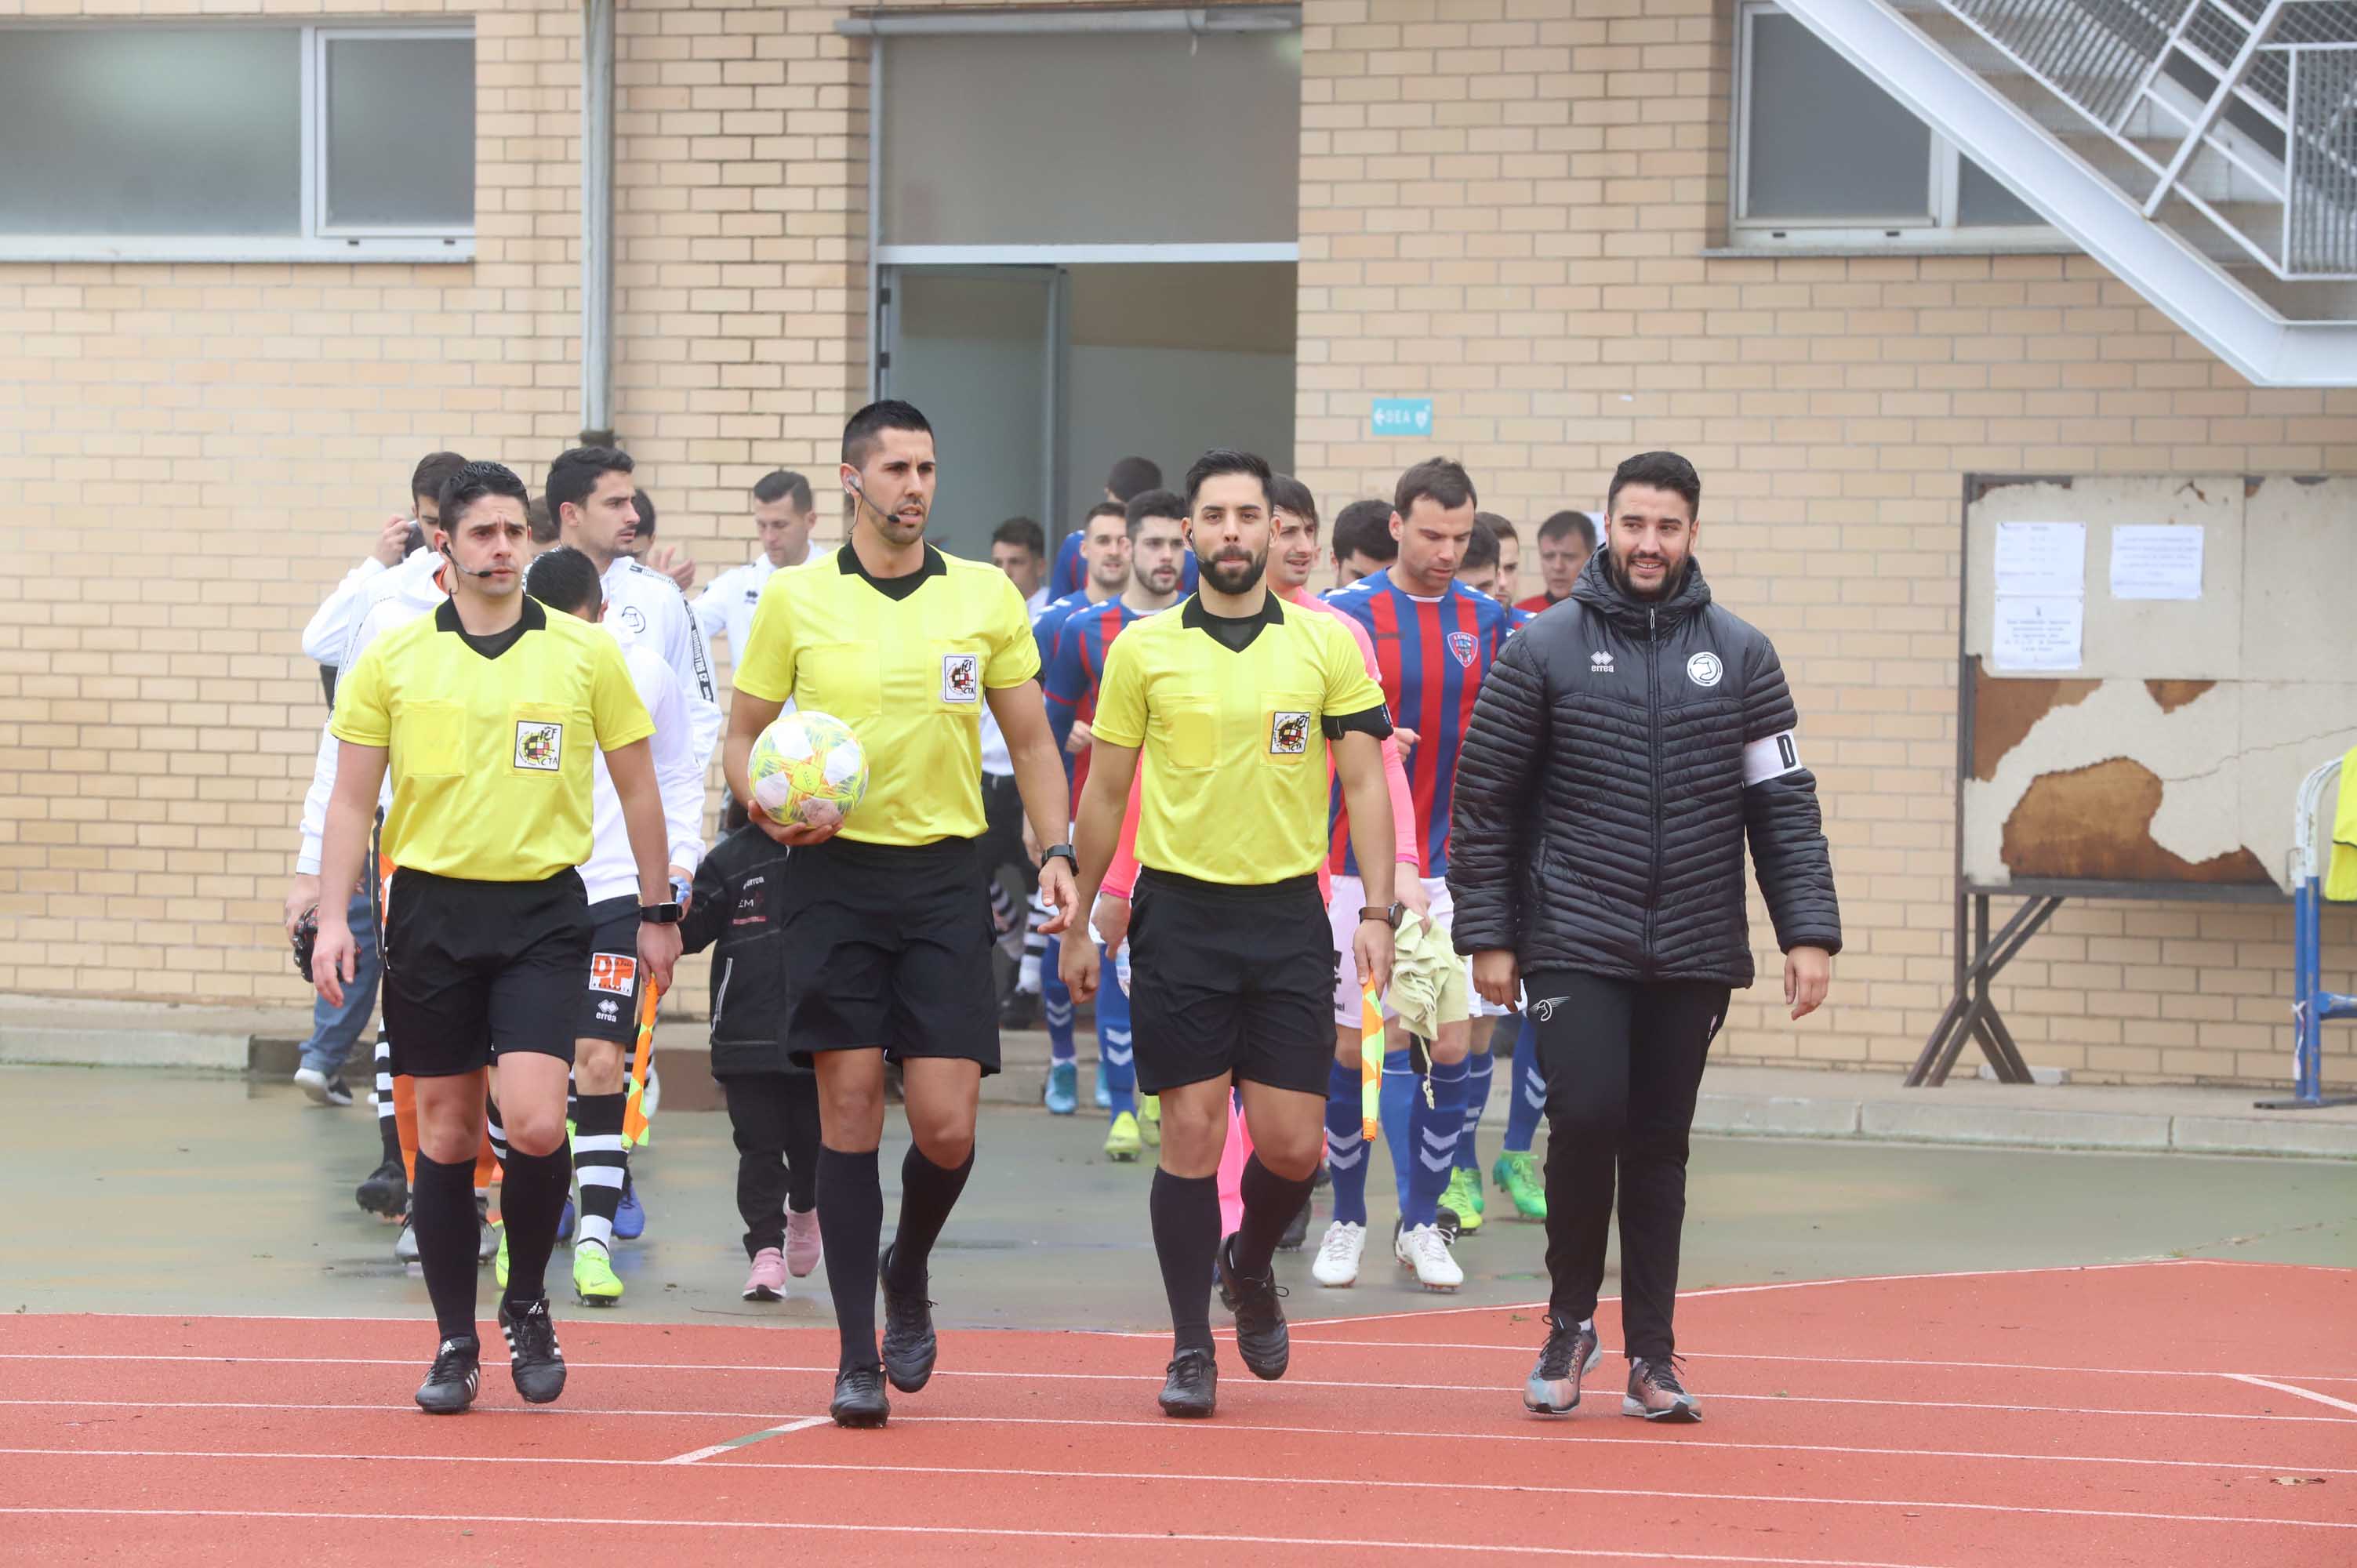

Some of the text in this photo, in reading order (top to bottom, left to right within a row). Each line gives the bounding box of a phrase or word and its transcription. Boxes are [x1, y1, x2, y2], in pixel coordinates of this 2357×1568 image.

[1386, 408, 1411, 424] DEA
[1776, 734, 1796, 769] D
[541, 757, 558, 765] CTA
[596, 1011, 617, 1022] errea
